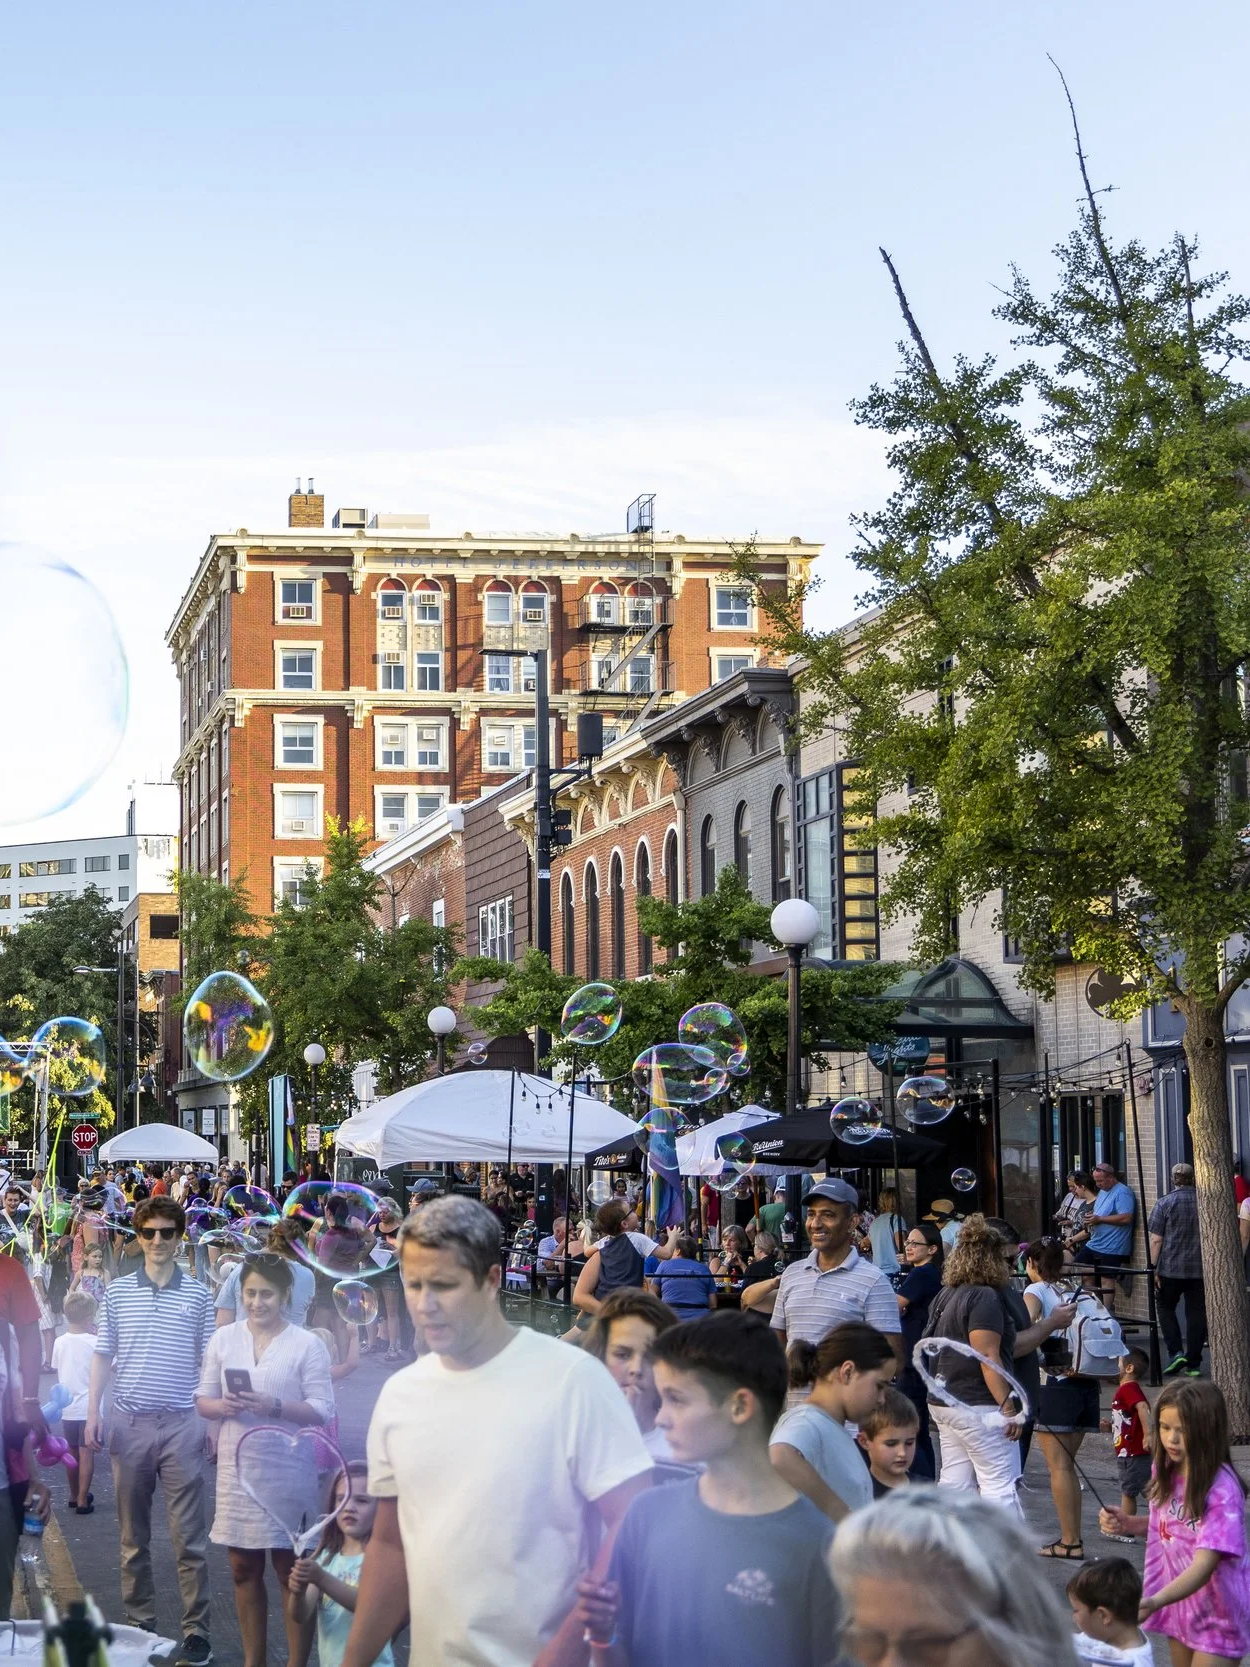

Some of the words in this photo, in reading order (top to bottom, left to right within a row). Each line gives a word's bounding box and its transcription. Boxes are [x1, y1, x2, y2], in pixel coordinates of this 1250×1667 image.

[394, 557, 469, 569] HOTEL
[495, 559, 638, 572] JEFFERSON
[73, 1132, 97, 1142] STOP
[593, 1155, 610, 1166] Tito's
